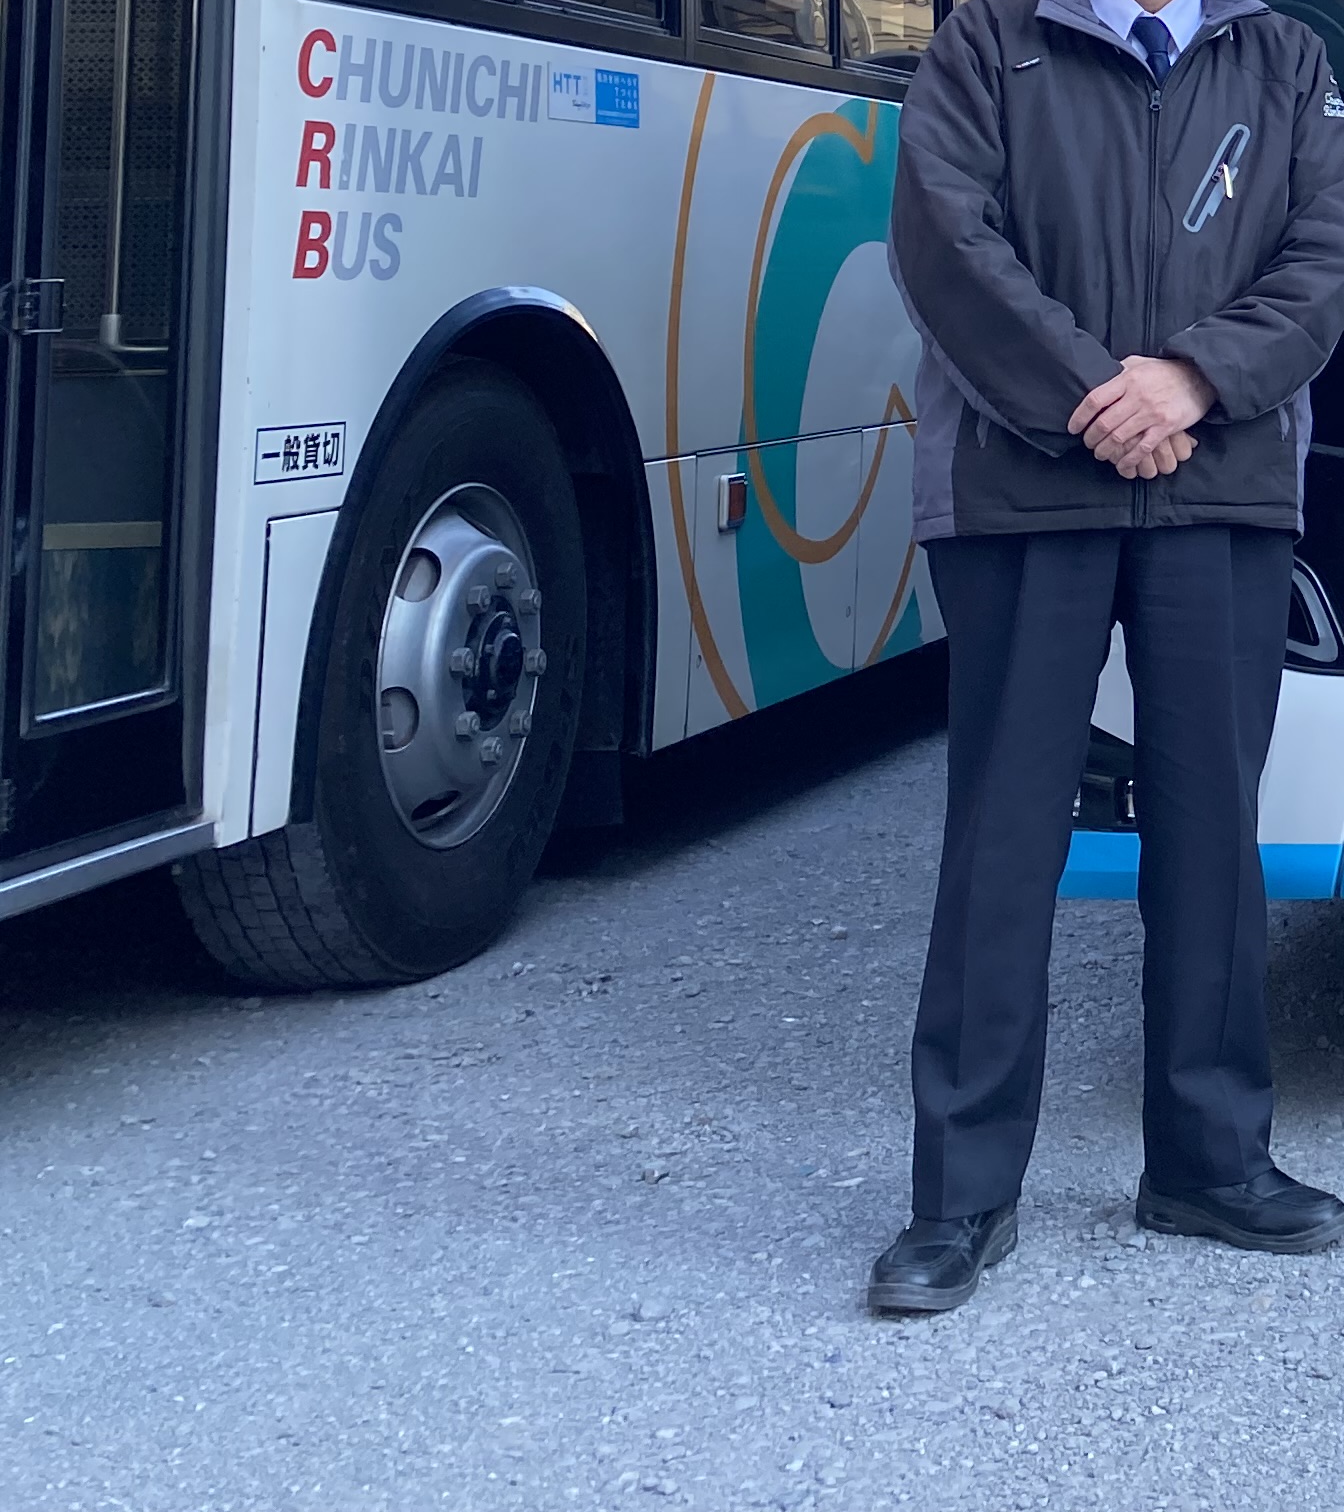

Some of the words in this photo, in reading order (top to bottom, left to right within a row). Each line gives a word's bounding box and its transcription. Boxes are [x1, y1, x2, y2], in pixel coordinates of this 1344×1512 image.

[297, 28, 543, 123] CHUNICHI
[553, 72, 582, 96] HTT
[295, 120, 483, 198] RINKAI
[292, 210, 403, 281] BUS
[261, 431, 340, 473] 一般貸切
